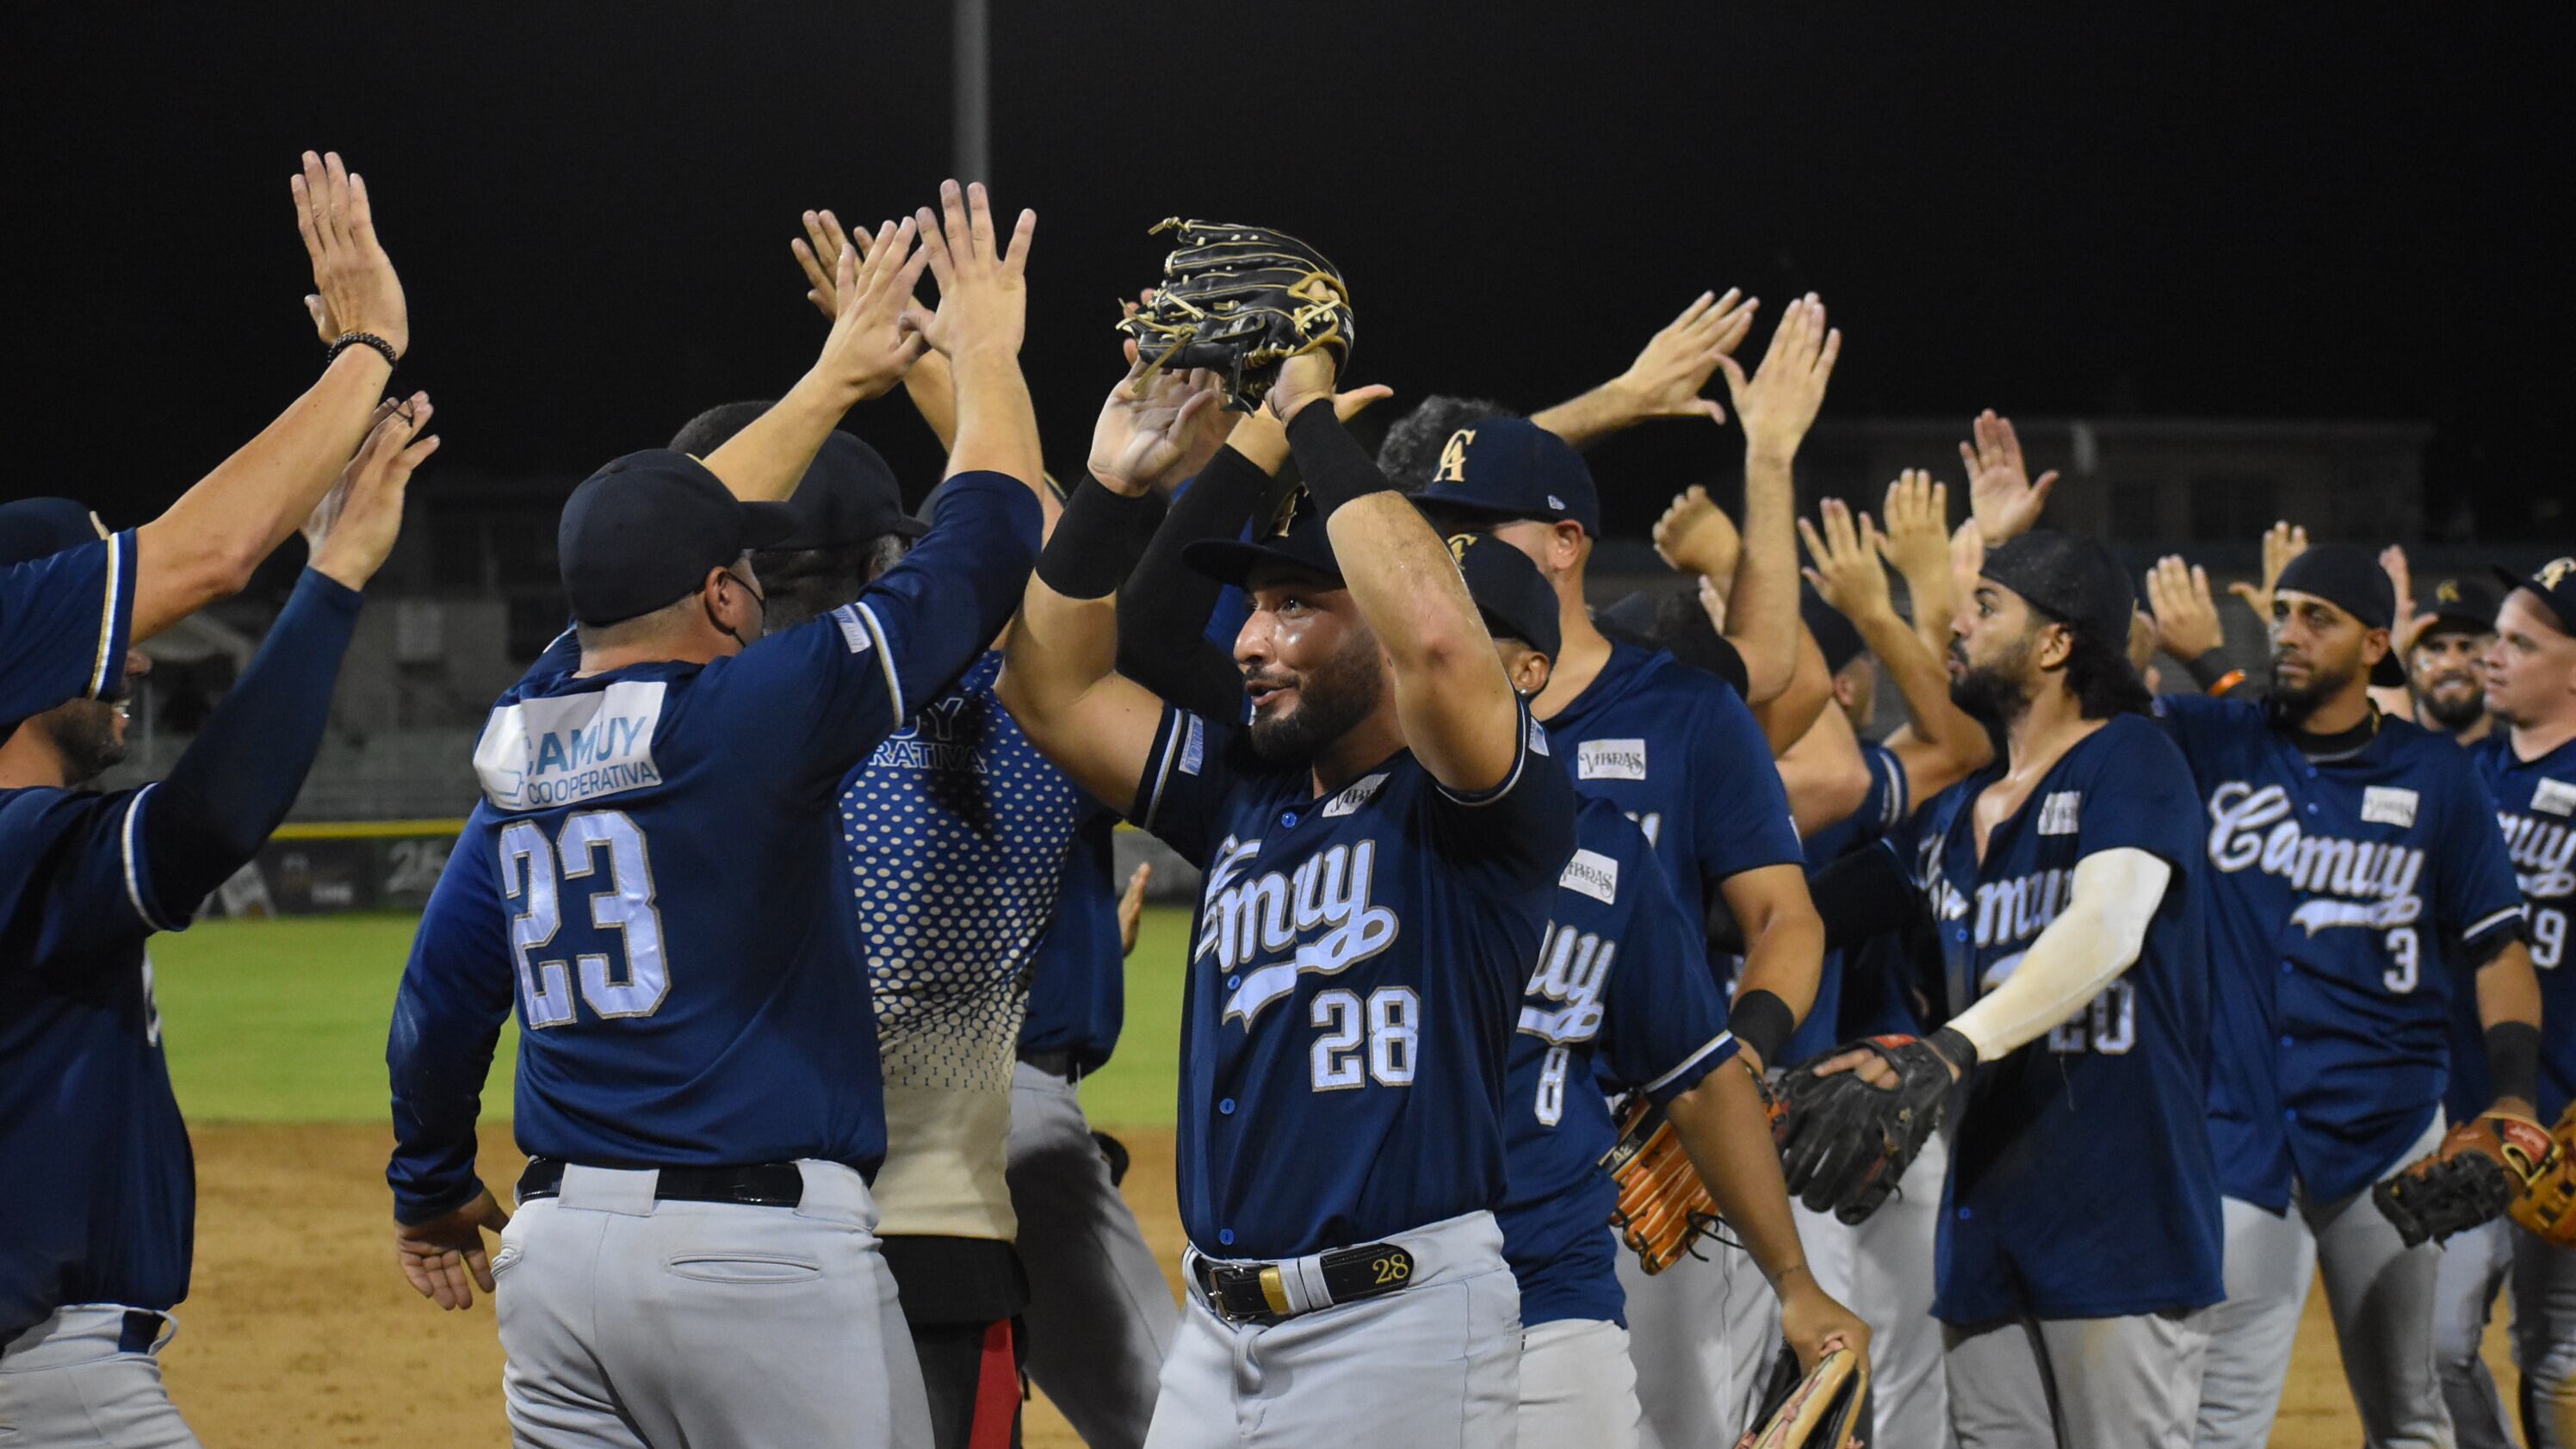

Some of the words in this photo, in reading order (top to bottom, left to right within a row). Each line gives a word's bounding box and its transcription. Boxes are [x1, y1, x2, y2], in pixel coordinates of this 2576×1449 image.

[526, 715, 647, 777] AMUY
[868, 741, 988, 774] RATIVA
[1579, 752, 1644, 776] VIBRAS
[527, 761, 659, 805] COOPERATIVA
[1561, 861, 1613, 899] IBRAS
[2208, 781, 2424, 938] Camuy
[498, 809, 672, 1030] 23
[2522, 903, 2567, 969] 9
[2382, 927, 2420, 994] 3
[1310, 986, 1421, 1093] 28
[1534, 1045, 1570, 1127] 8
[1372, 1254, 1409, 1285] 28
